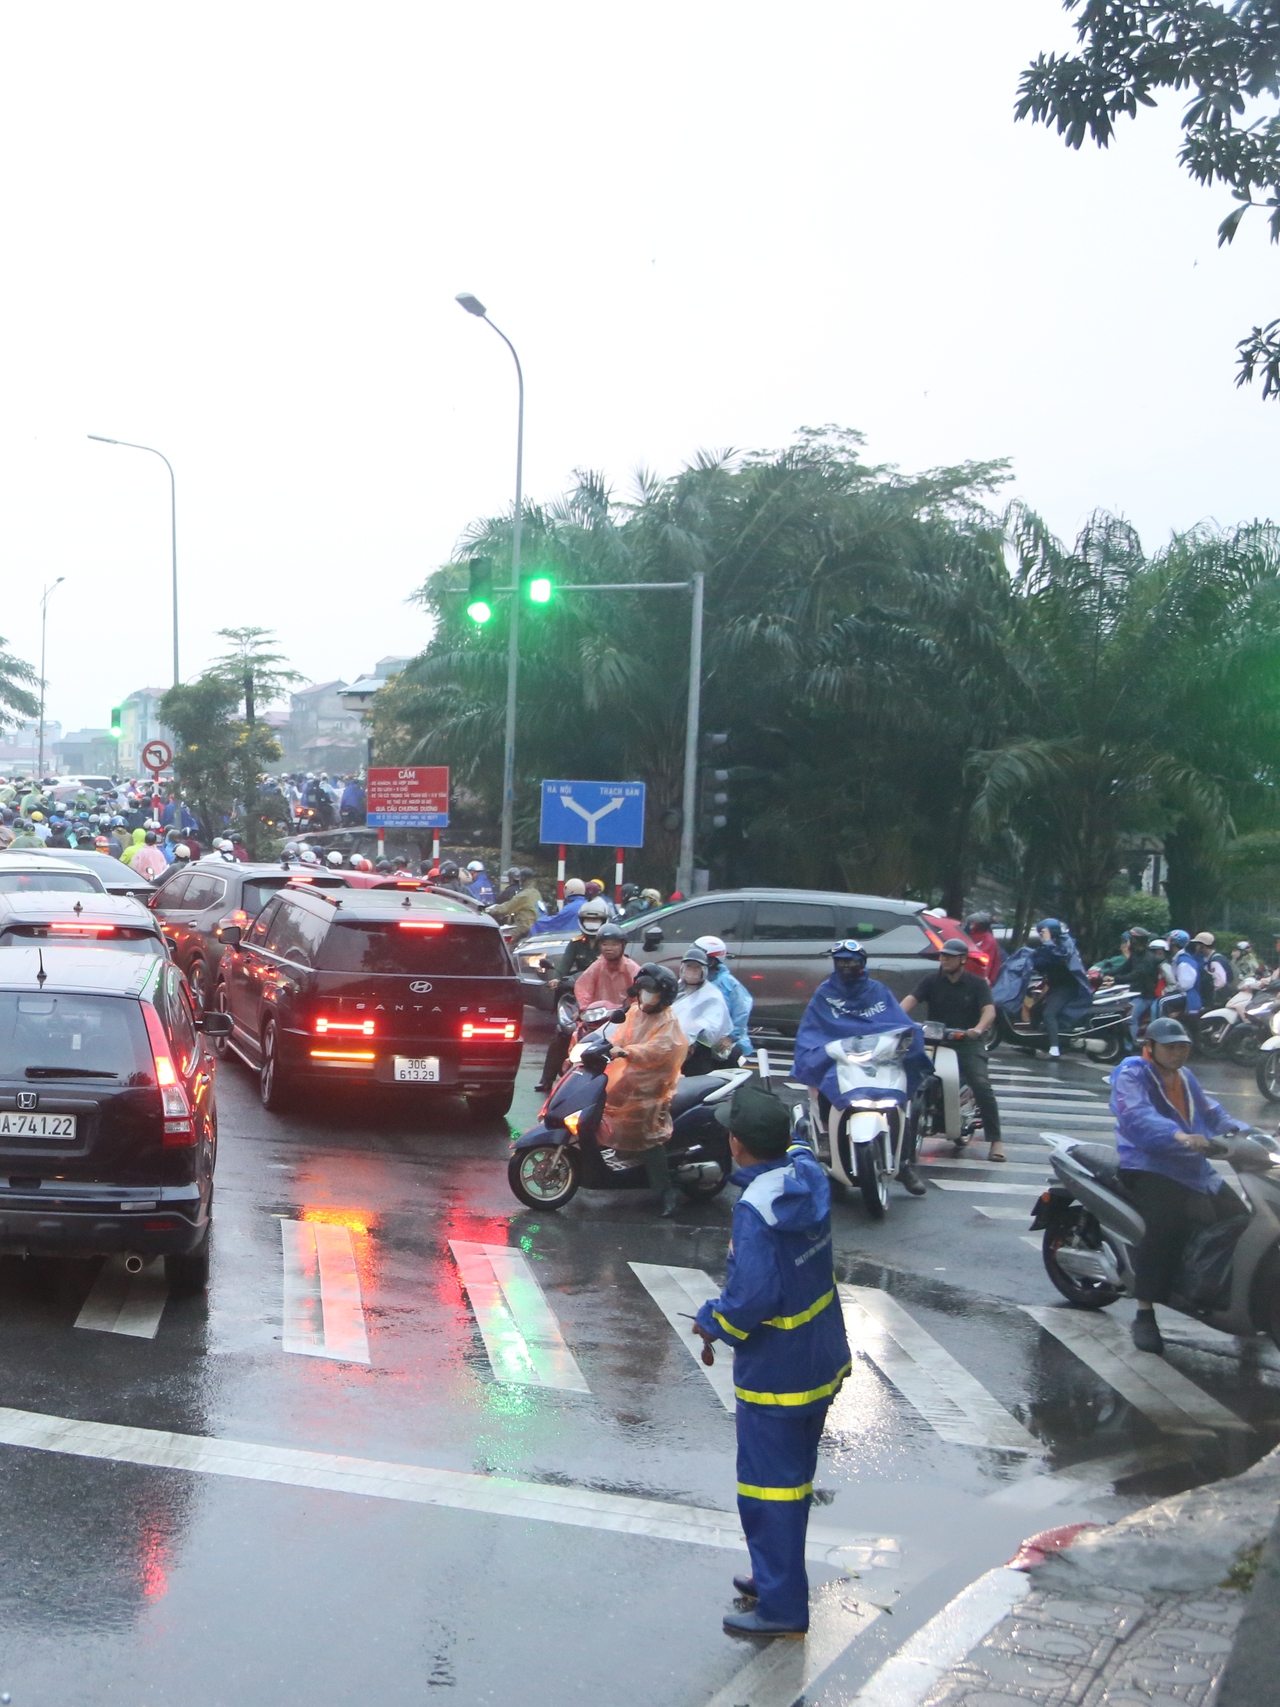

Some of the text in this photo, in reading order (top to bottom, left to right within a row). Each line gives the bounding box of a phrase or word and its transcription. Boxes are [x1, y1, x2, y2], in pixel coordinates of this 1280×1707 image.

[398, 768, 416, 779] CẤM
[547, 784, 556, 793] HÀ
[600, 787, 622, 796] THẠCH
[356, 1003, 442, 1012] SANTA
[408, 1060, 426, 1069] 30G
[400, 1070, 435, 1080] 613.29
